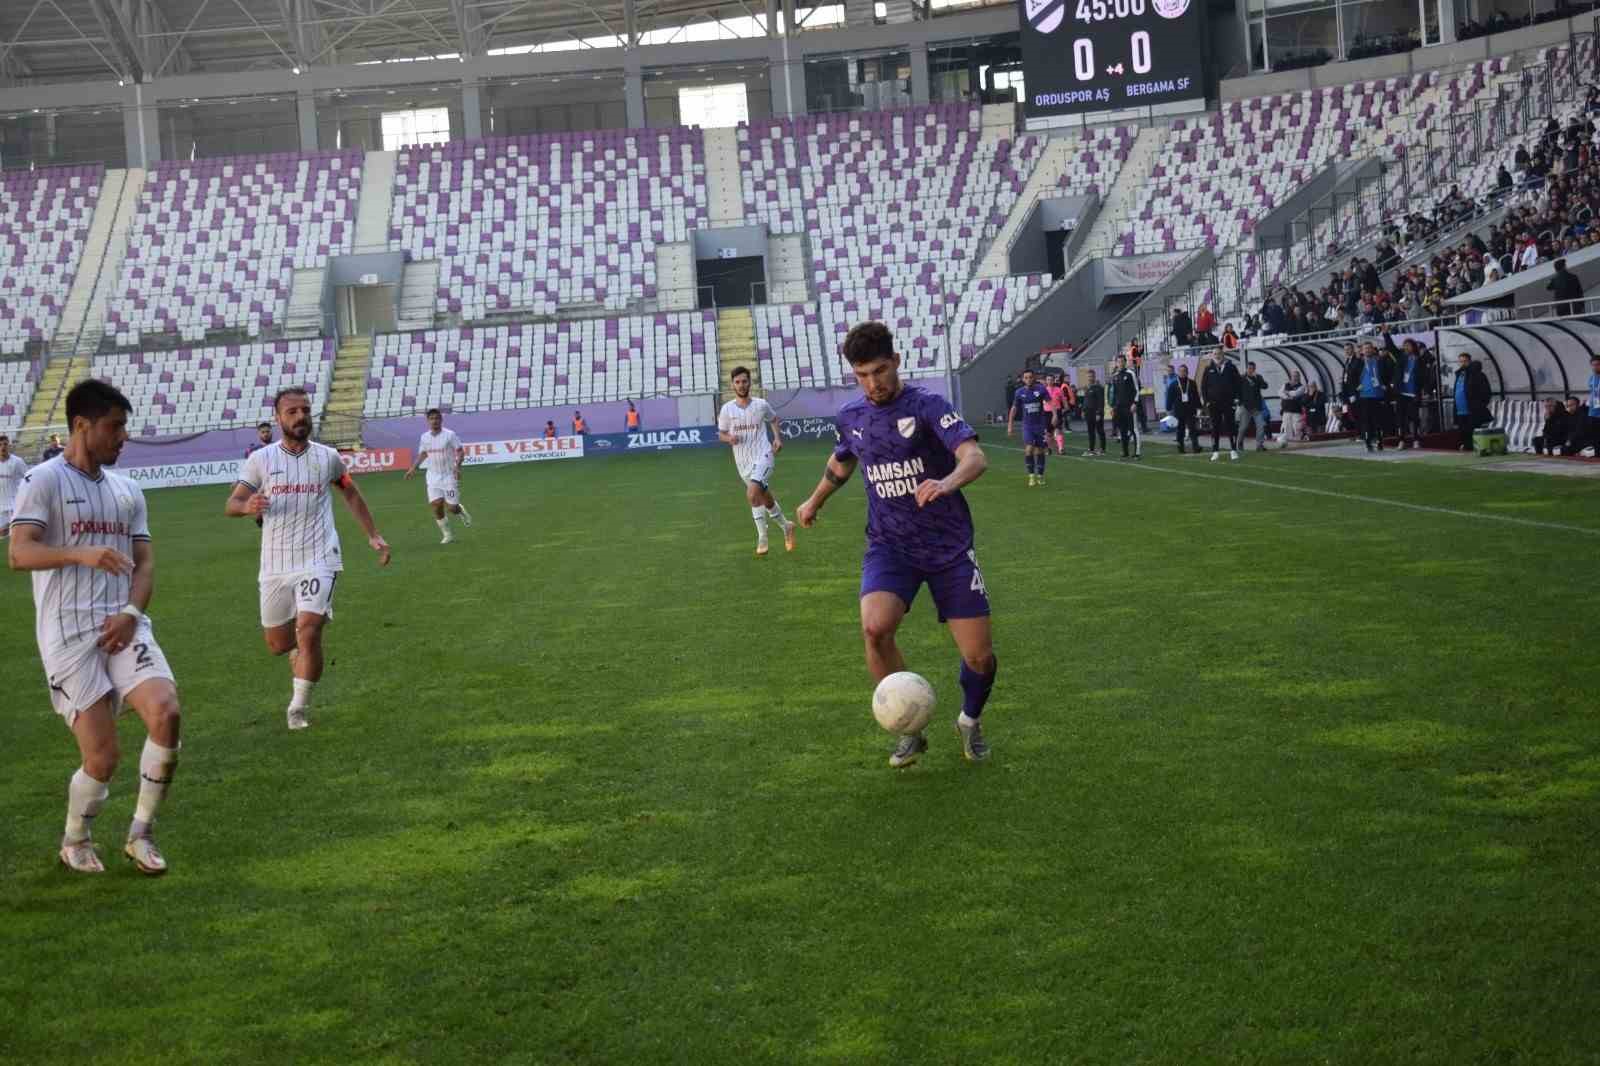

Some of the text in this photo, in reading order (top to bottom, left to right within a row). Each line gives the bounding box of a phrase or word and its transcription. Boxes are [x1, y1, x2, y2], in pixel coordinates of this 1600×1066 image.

[1075, 0, 1146, 24] 45:00
[1073, 30, 1152, 81] 0 0
[1106, 63, 1124, 76] +4
[1035, 88, 1111, 106] ORDUSPOR AŞ
[1126, 77, 1191, 97] BERGAMA SF
[505, 438, 581, 454] VESTEL
[129, 462, 240, 480] RAMADANLAR
[875, 477, 918, 499] ORDU
[300, 577, 321, 597] 20
[133, 643, 150, 664] 2
